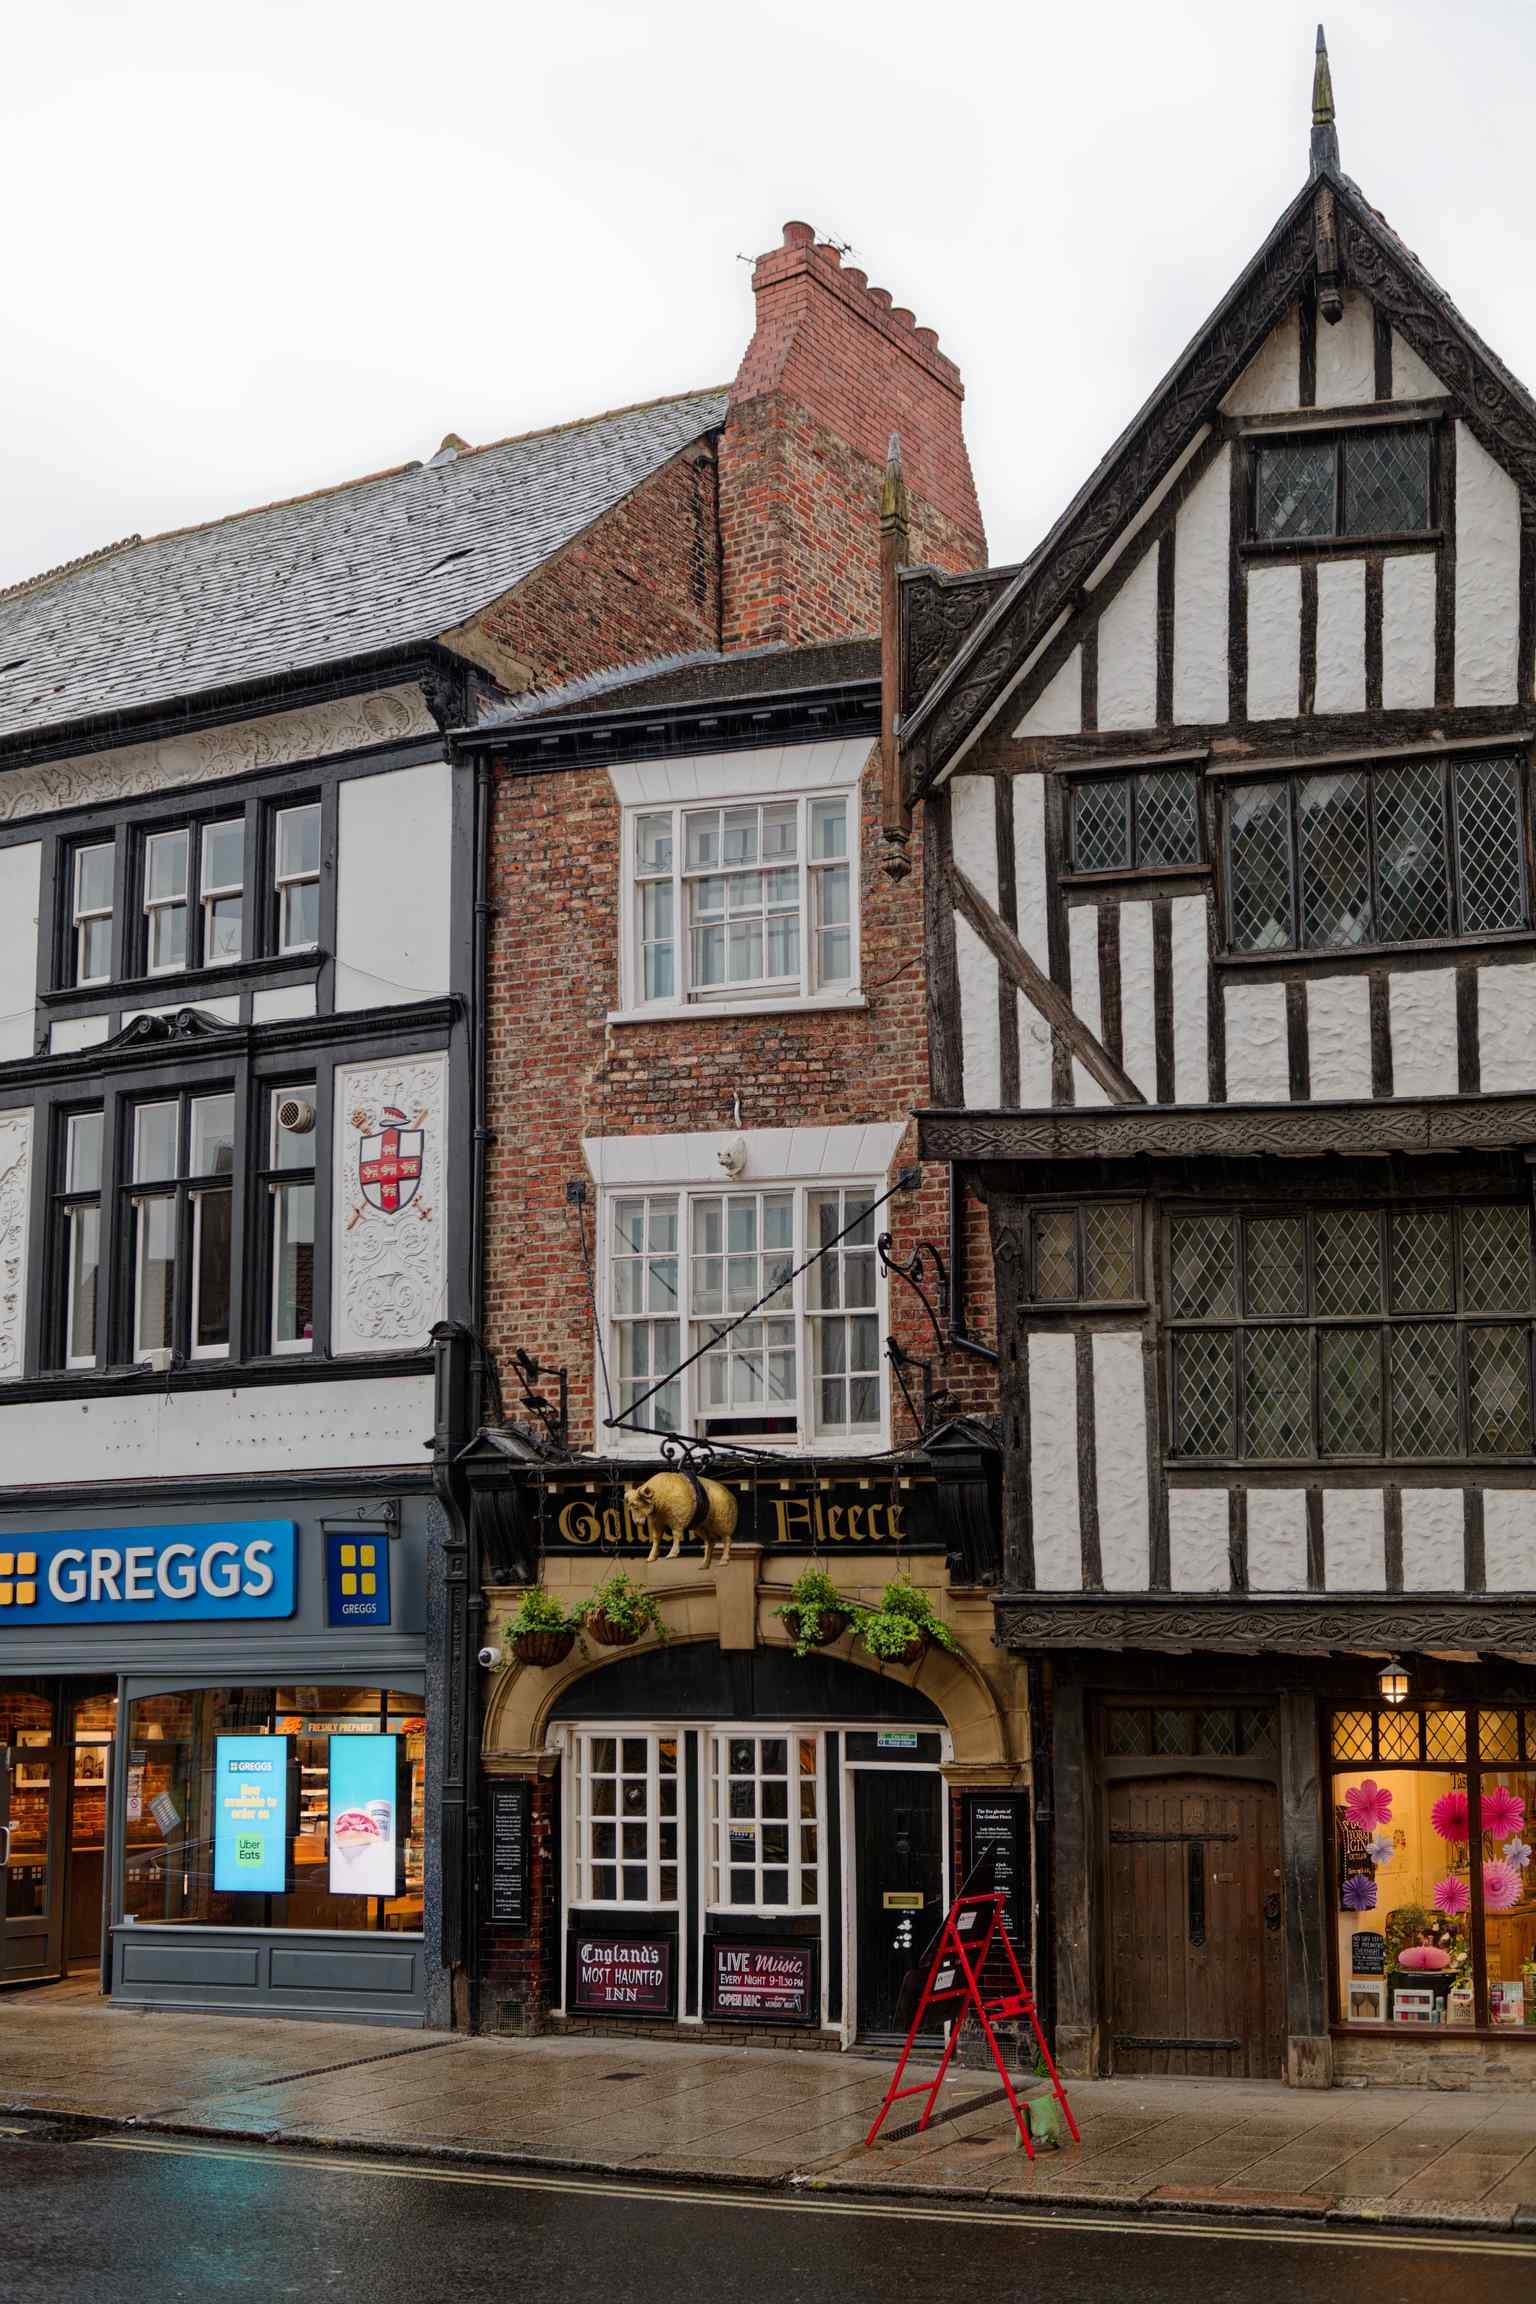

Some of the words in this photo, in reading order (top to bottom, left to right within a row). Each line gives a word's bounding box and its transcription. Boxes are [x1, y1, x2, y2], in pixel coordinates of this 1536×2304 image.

[769, 1496, 906, 1544] Fleece
[48, 1540, 274, 1603] GREGGS
[342, 1604, 377, 1614] GREGGS
[239, 1761, 272, 1771] GREGGS
[239, 1840, 261, 1850] Uber
[239, 1850, 261, 1860] Eats
[581, 1943, 659, 1964] England's
[718, 1952, 750, 1972] LIVE
[582, 1966, 611, 1984] MOST
[614, 1968, 662, 1986] HAUNTED
[720, 1973, 741, 1985] EVERY
[744, 1974, 766, 1985] NIGHT
[605, 1987, 638, 2001] INN
[718, 1994, 742, 2006] OPEN
